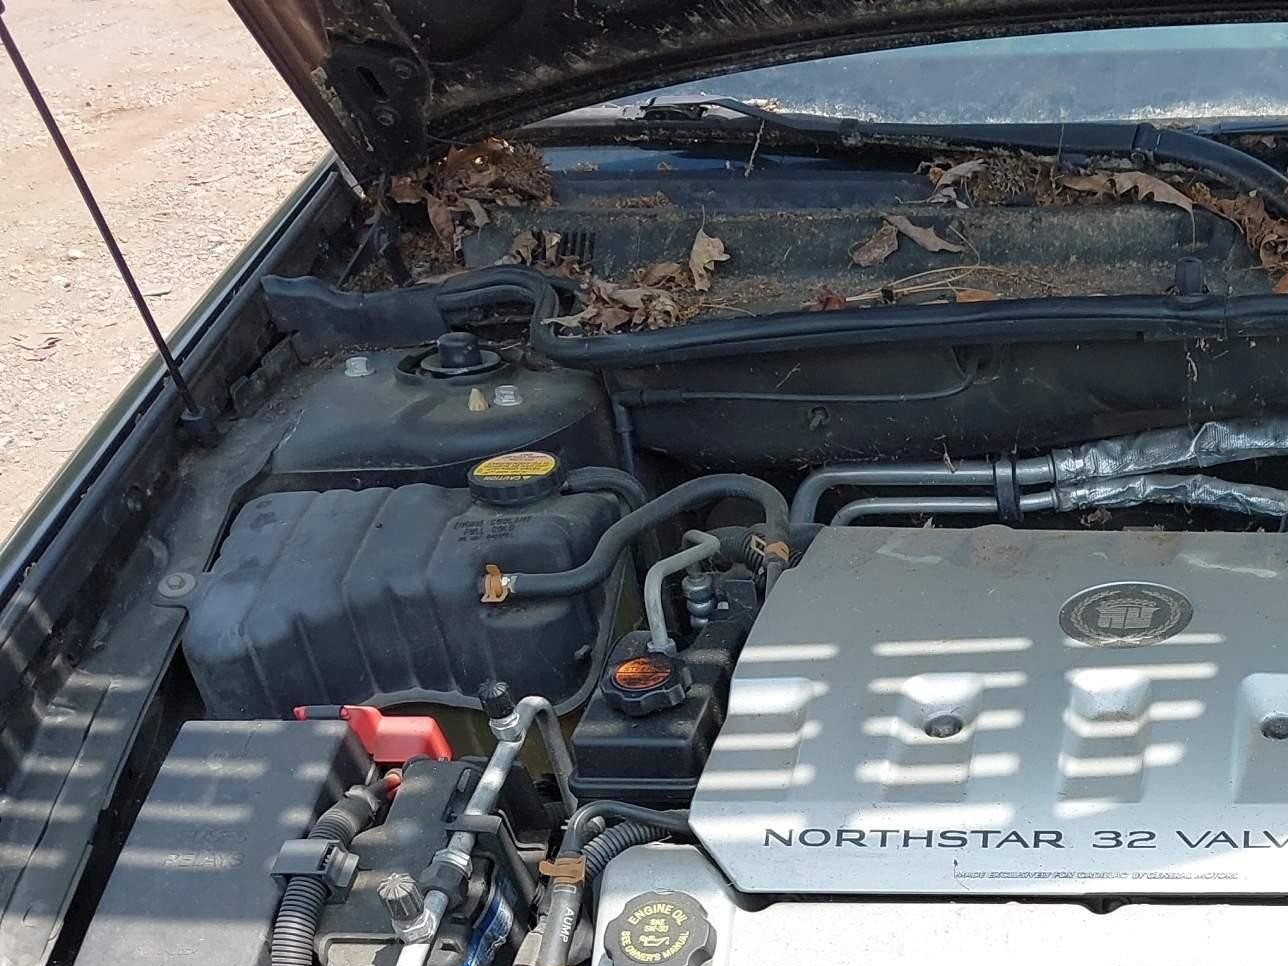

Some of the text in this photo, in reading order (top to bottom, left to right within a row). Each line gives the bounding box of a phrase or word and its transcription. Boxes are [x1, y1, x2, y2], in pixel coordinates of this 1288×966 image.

[763, 828, 1064, 849] NORTHSTAR
[1092, 830, 1157, 849] 32
[163, 852, 242, 868] RELAYS
[989, 871, 1051, 879] EXCLUSIVELY
[1053, 871, 1074, 879] FOR
[1077, 871, 1128, 879] CADILLAC
[1147, 871, 1192, 879] GENERAL
[1194, 871, 1239, 879] MOTORS
[559, 906, 575, 943] AUMP
[627, 903, 688, 926] ENGINE OIL
[621, 930, 690, 962] SEE OWNER'S MANUAL
